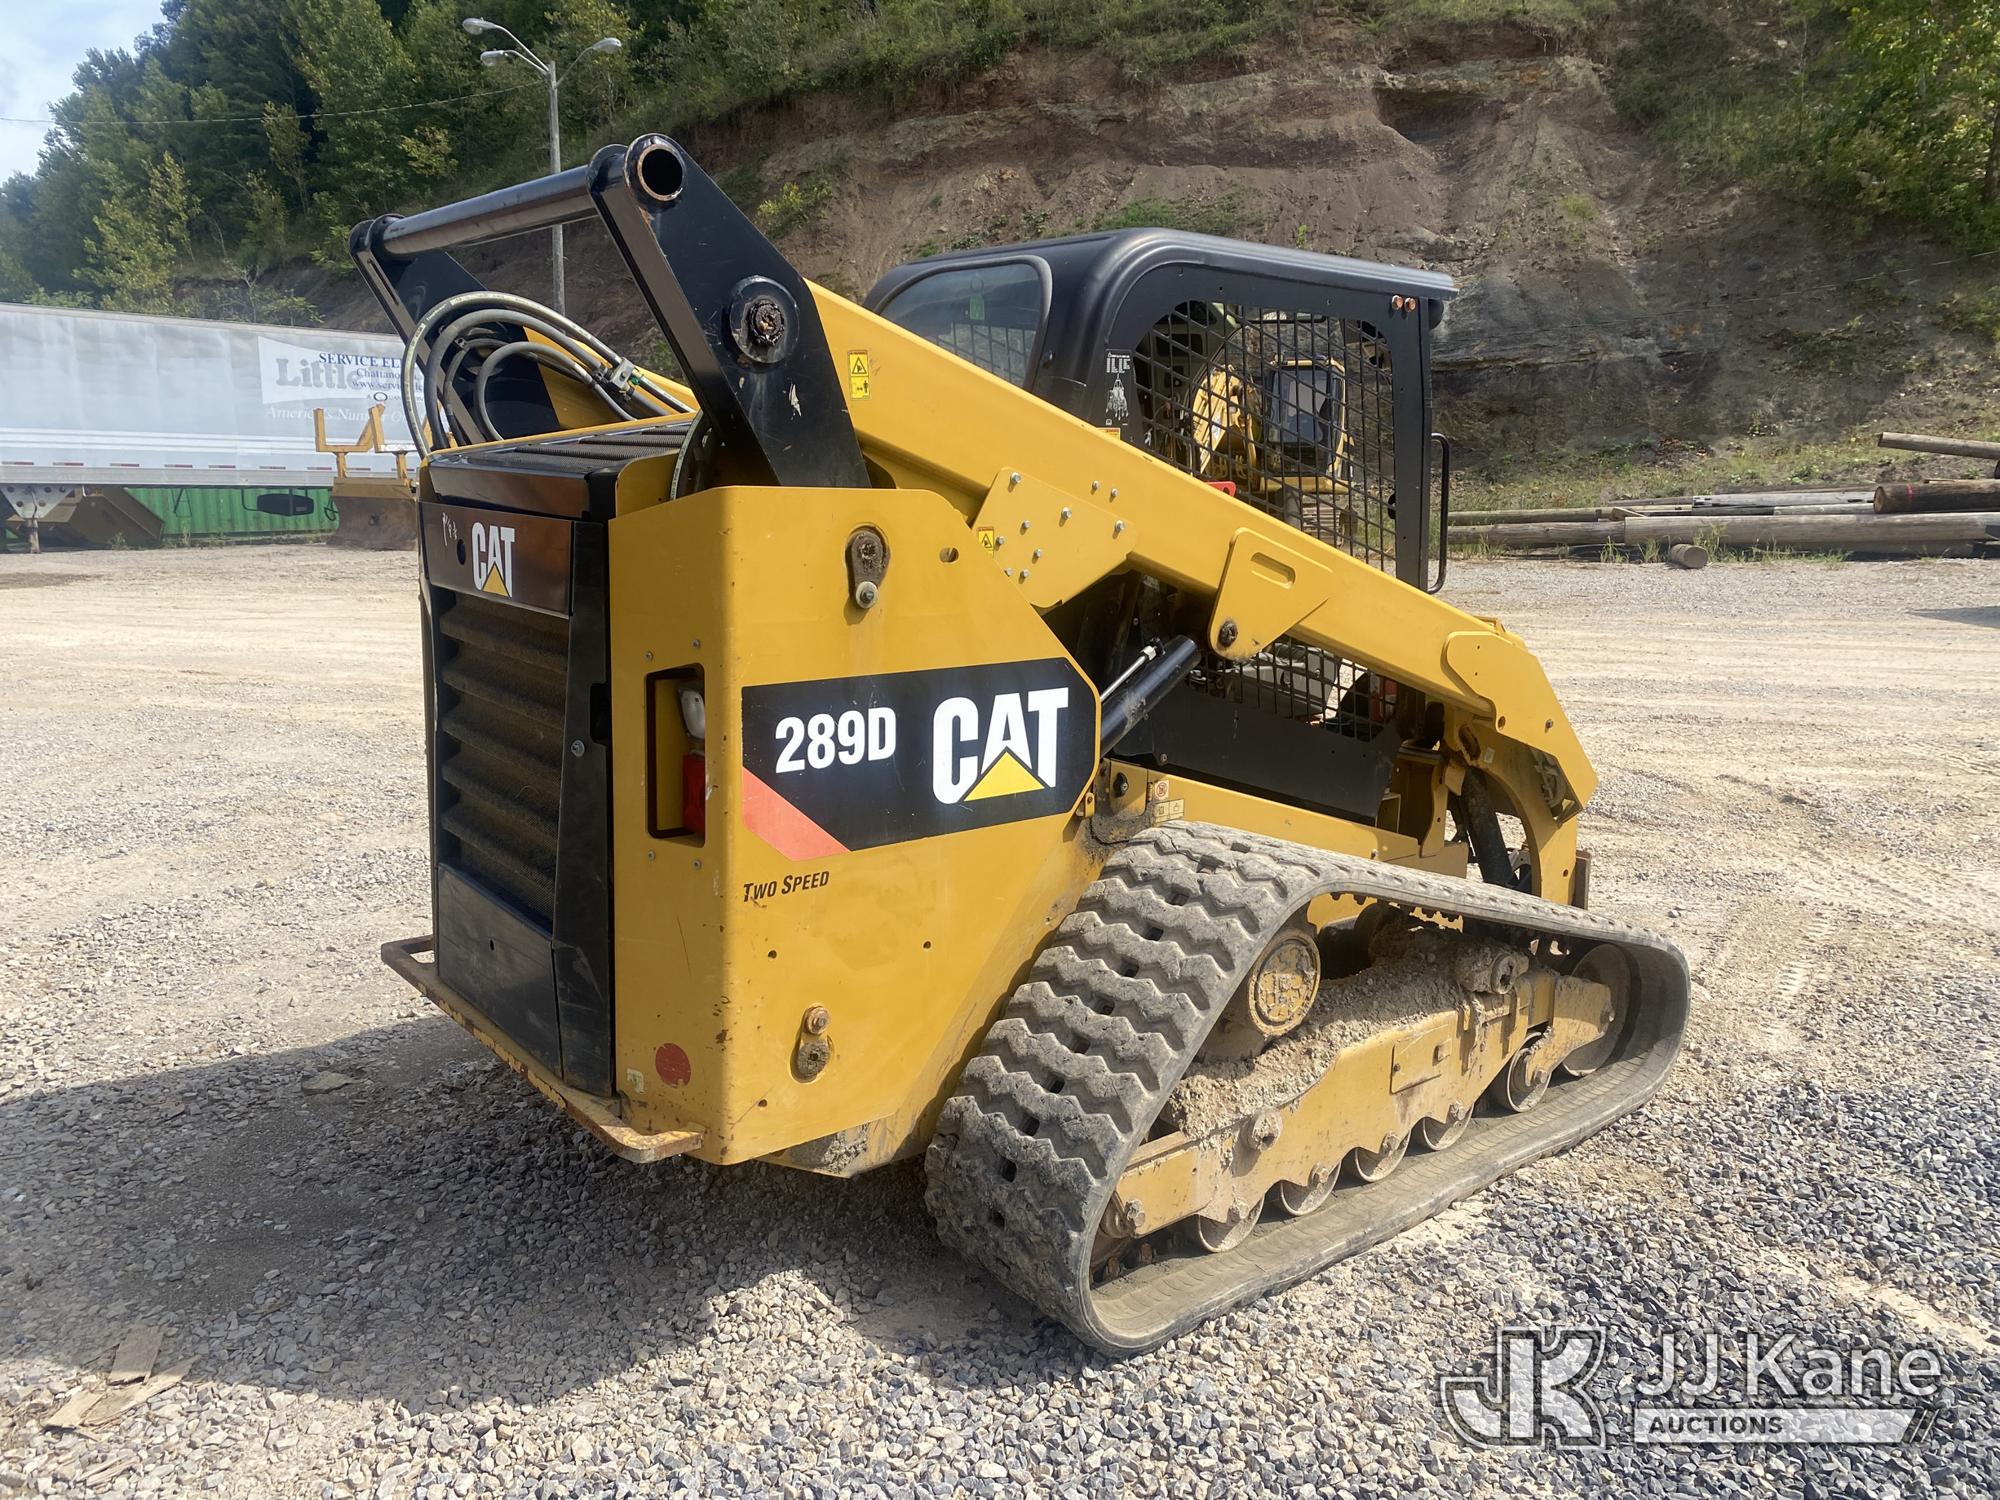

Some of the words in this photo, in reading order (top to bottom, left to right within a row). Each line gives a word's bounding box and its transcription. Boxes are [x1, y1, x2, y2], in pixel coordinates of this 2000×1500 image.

[276, 358, 363, 391] Little
[319, 353, 378, 367] SERVICE
[382, 357, 401, 369] EL
[356, 368, 400, 379] Chattano
[472, 521, 515, 598] CAT
[775, 706, 897, 774] 289D
[932, 687, 1069, 804] CAT
